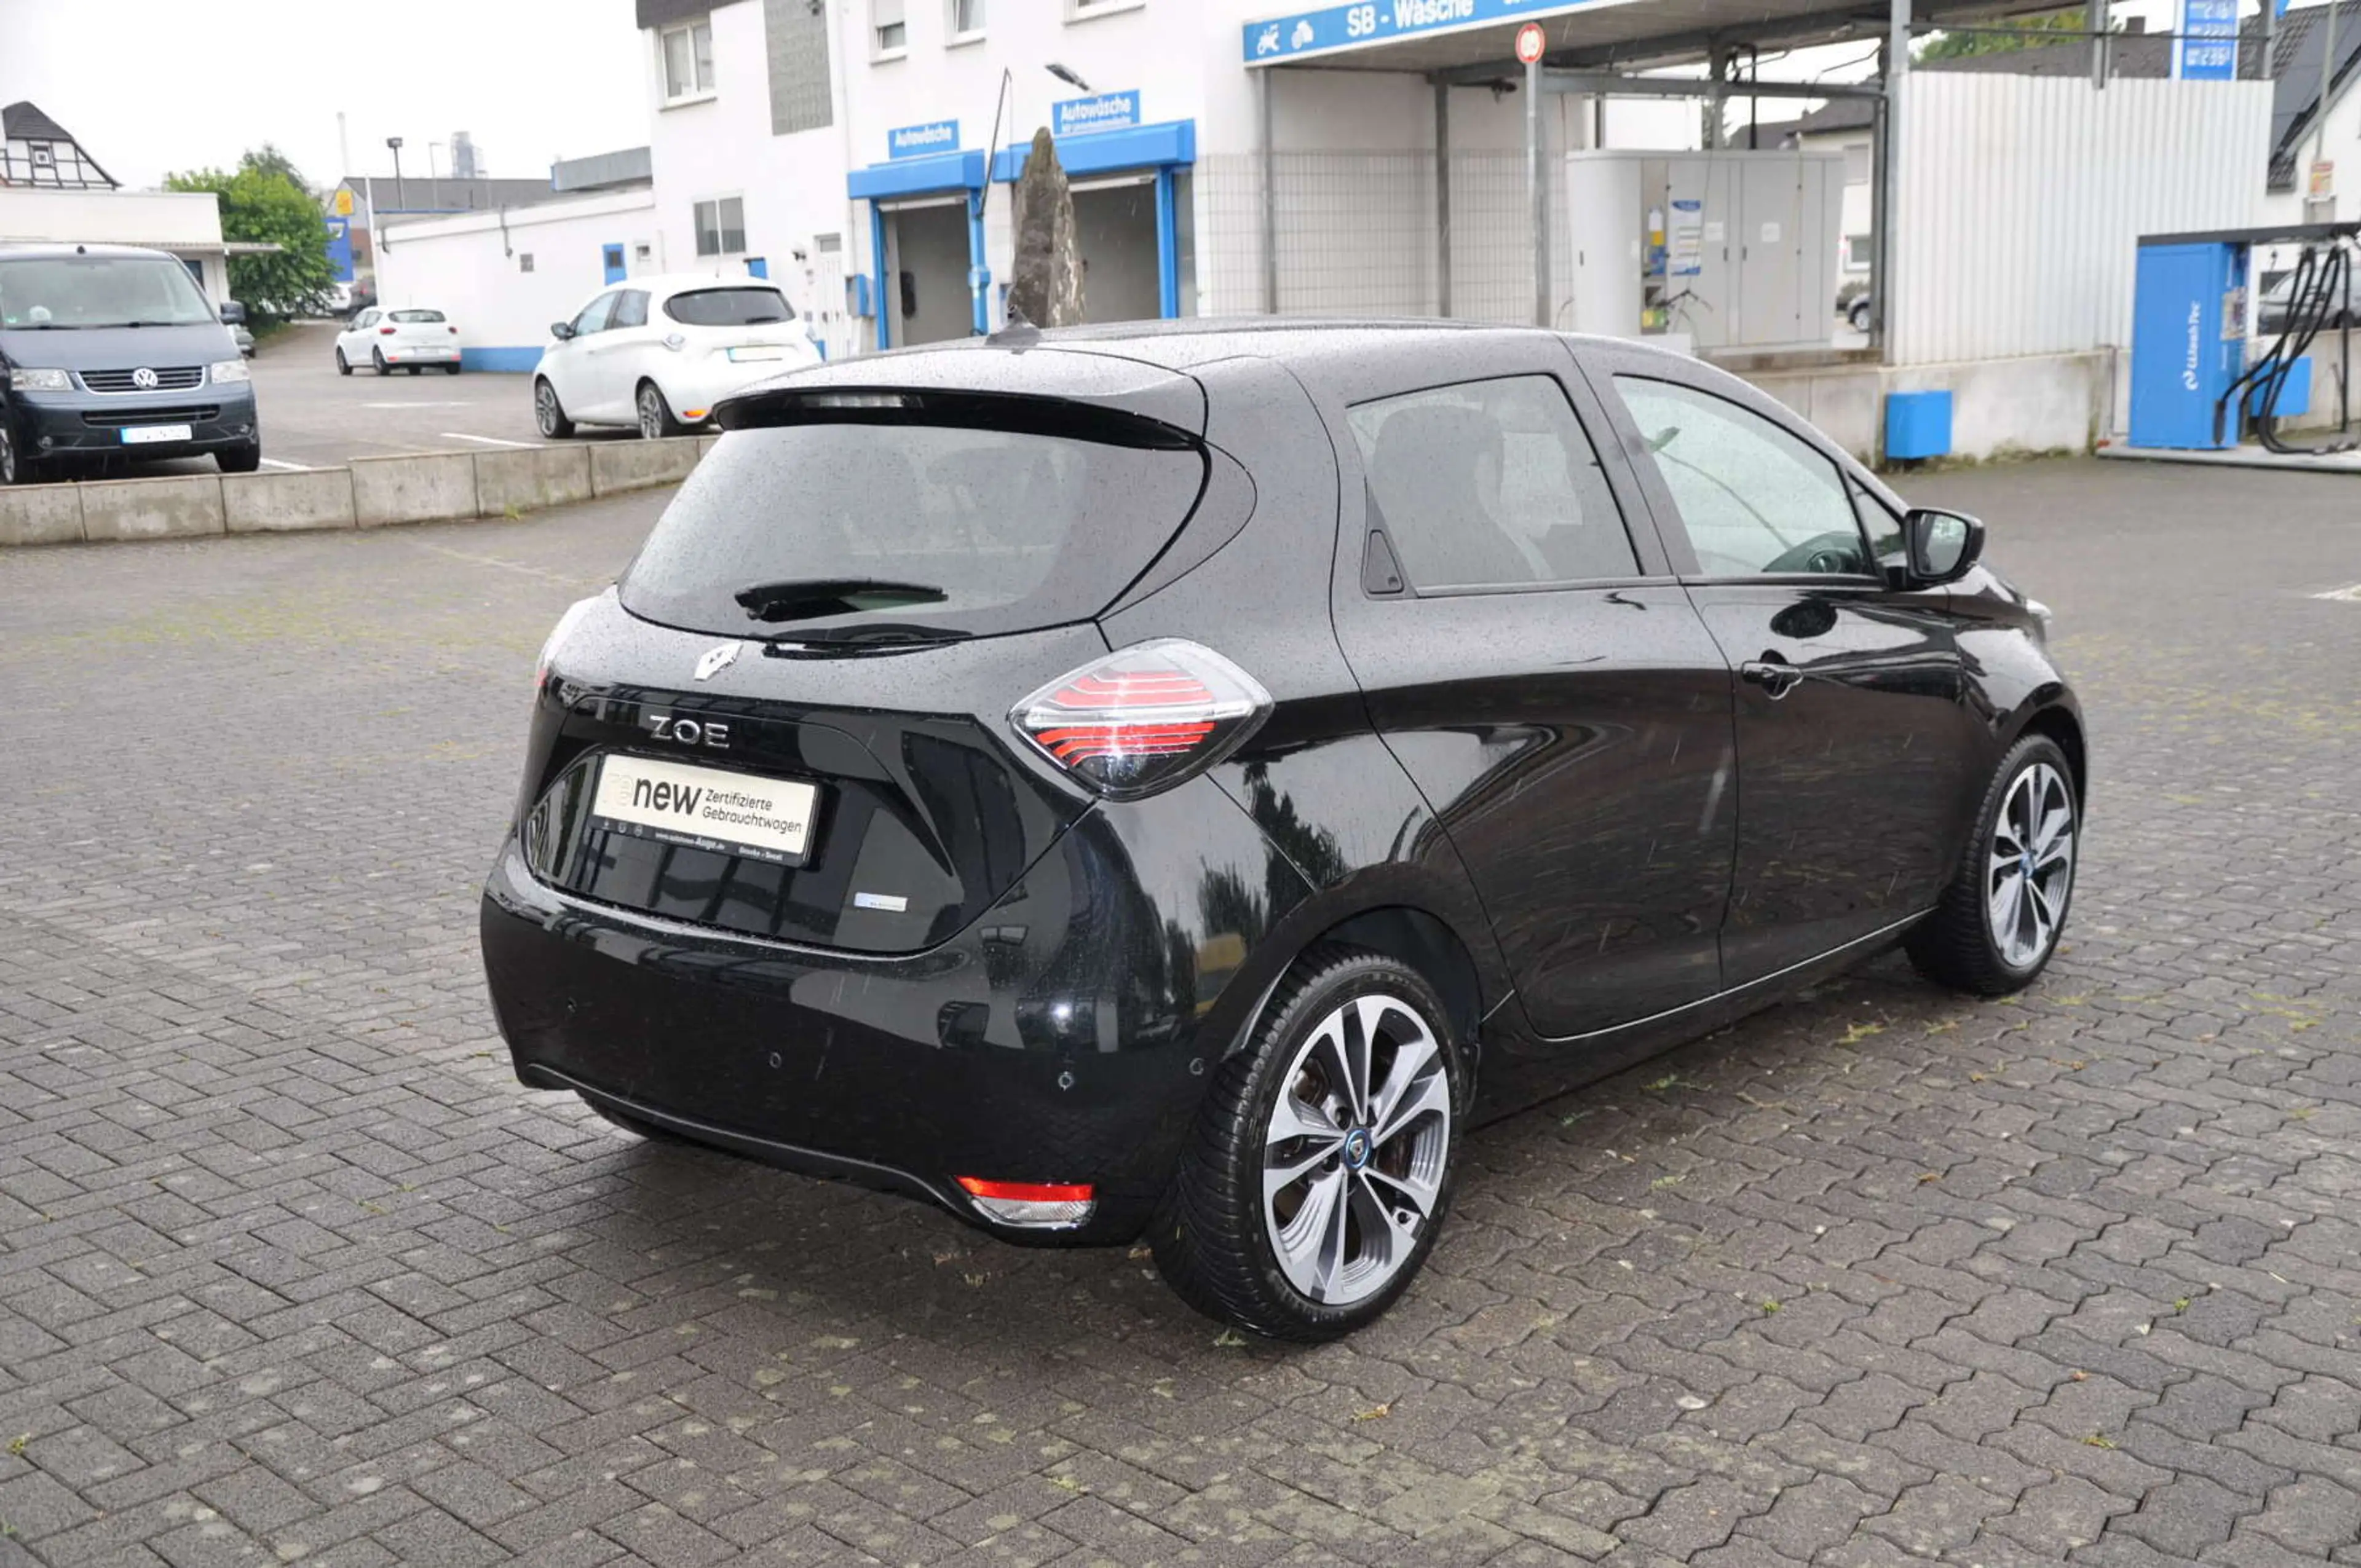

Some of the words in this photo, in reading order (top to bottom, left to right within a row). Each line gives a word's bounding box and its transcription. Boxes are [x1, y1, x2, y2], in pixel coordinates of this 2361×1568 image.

[1347, 5, 1376, 37] SB
[1061, 94, 1131, 120] Autowäsche
[649, 714, 730, 747] ZOE
[705, 788, 773, 811] Zertifizierte
[702, 806, 802, 834] Gebrauchtwagen
